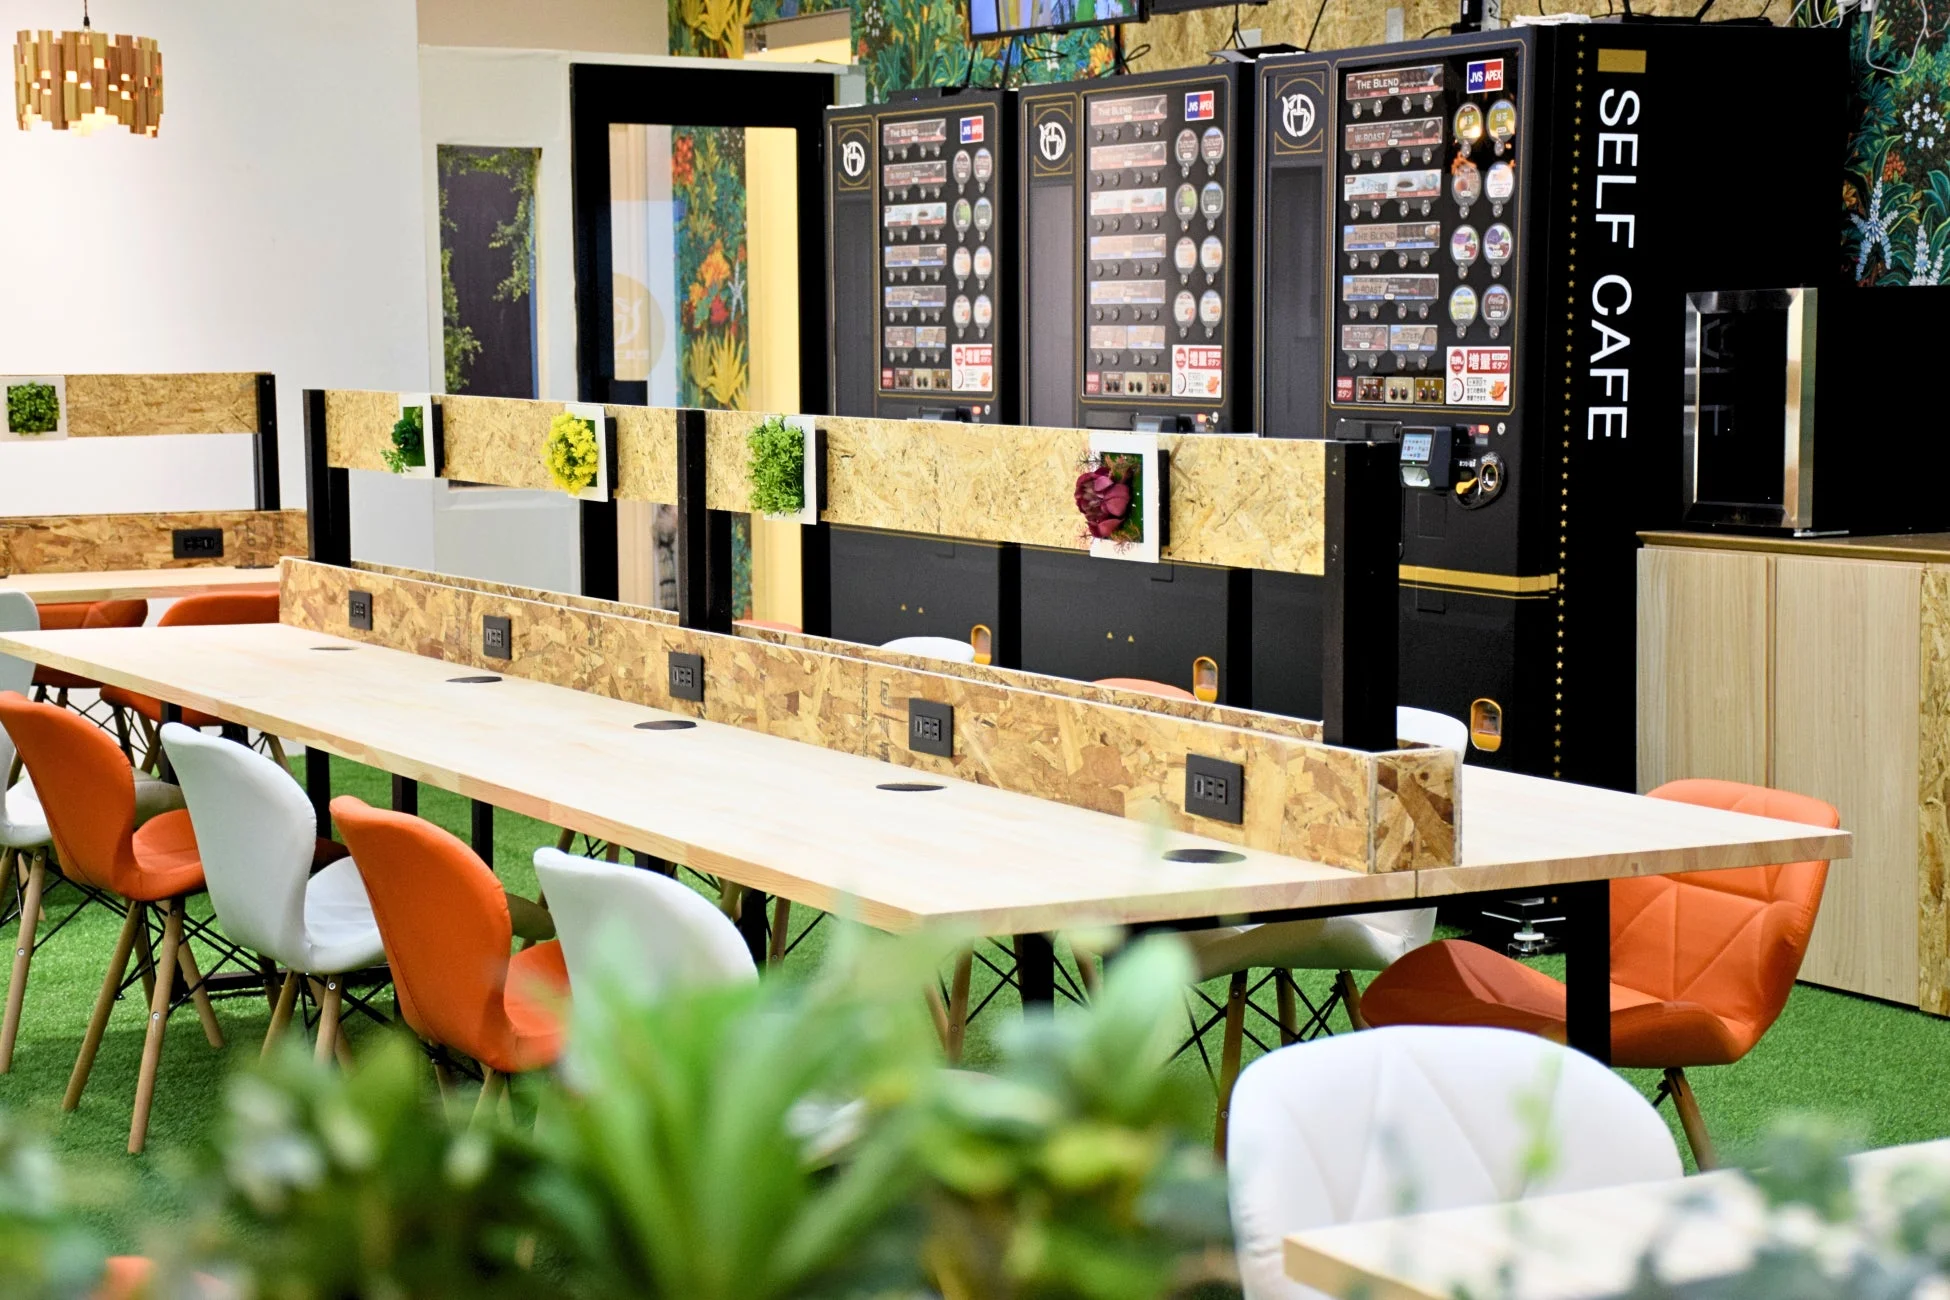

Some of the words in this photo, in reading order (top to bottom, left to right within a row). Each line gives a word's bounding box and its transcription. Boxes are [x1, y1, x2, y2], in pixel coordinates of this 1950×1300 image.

[1356, 79, 1371, 90] THE
[1373, 77, 1399, 88] BLEND
[1470, 71, 1483, 83] JVS
[1485, 69, 1502, 82] APEX
[1596, 88, 1641, 249] SELF
[1468, 352, 1491, 371] 増量
[1588, 274, 1632, 442] CAFE
